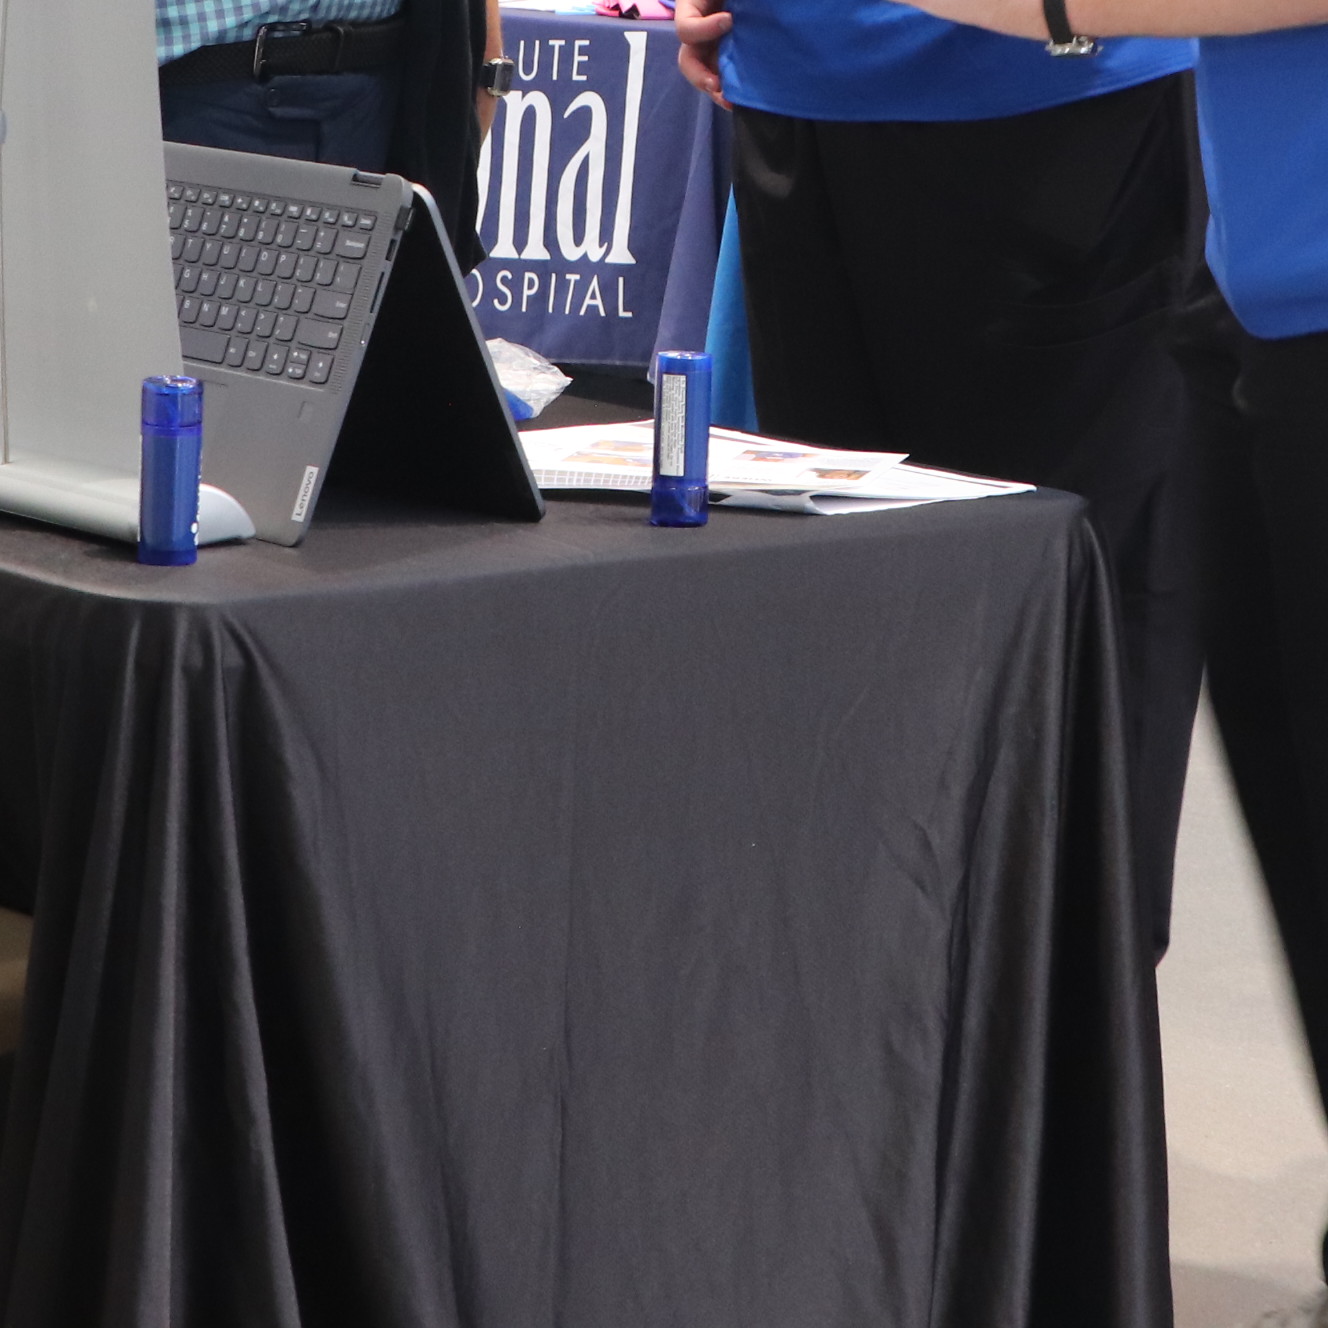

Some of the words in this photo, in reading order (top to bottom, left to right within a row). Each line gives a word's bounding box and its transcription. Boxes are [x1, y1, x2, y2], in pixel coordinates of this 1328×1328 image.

[518, 39, 590, 82] UTE
[470, 268, 633, 318] OSPITAL
[295, 470, 314, 518] Lenovo
